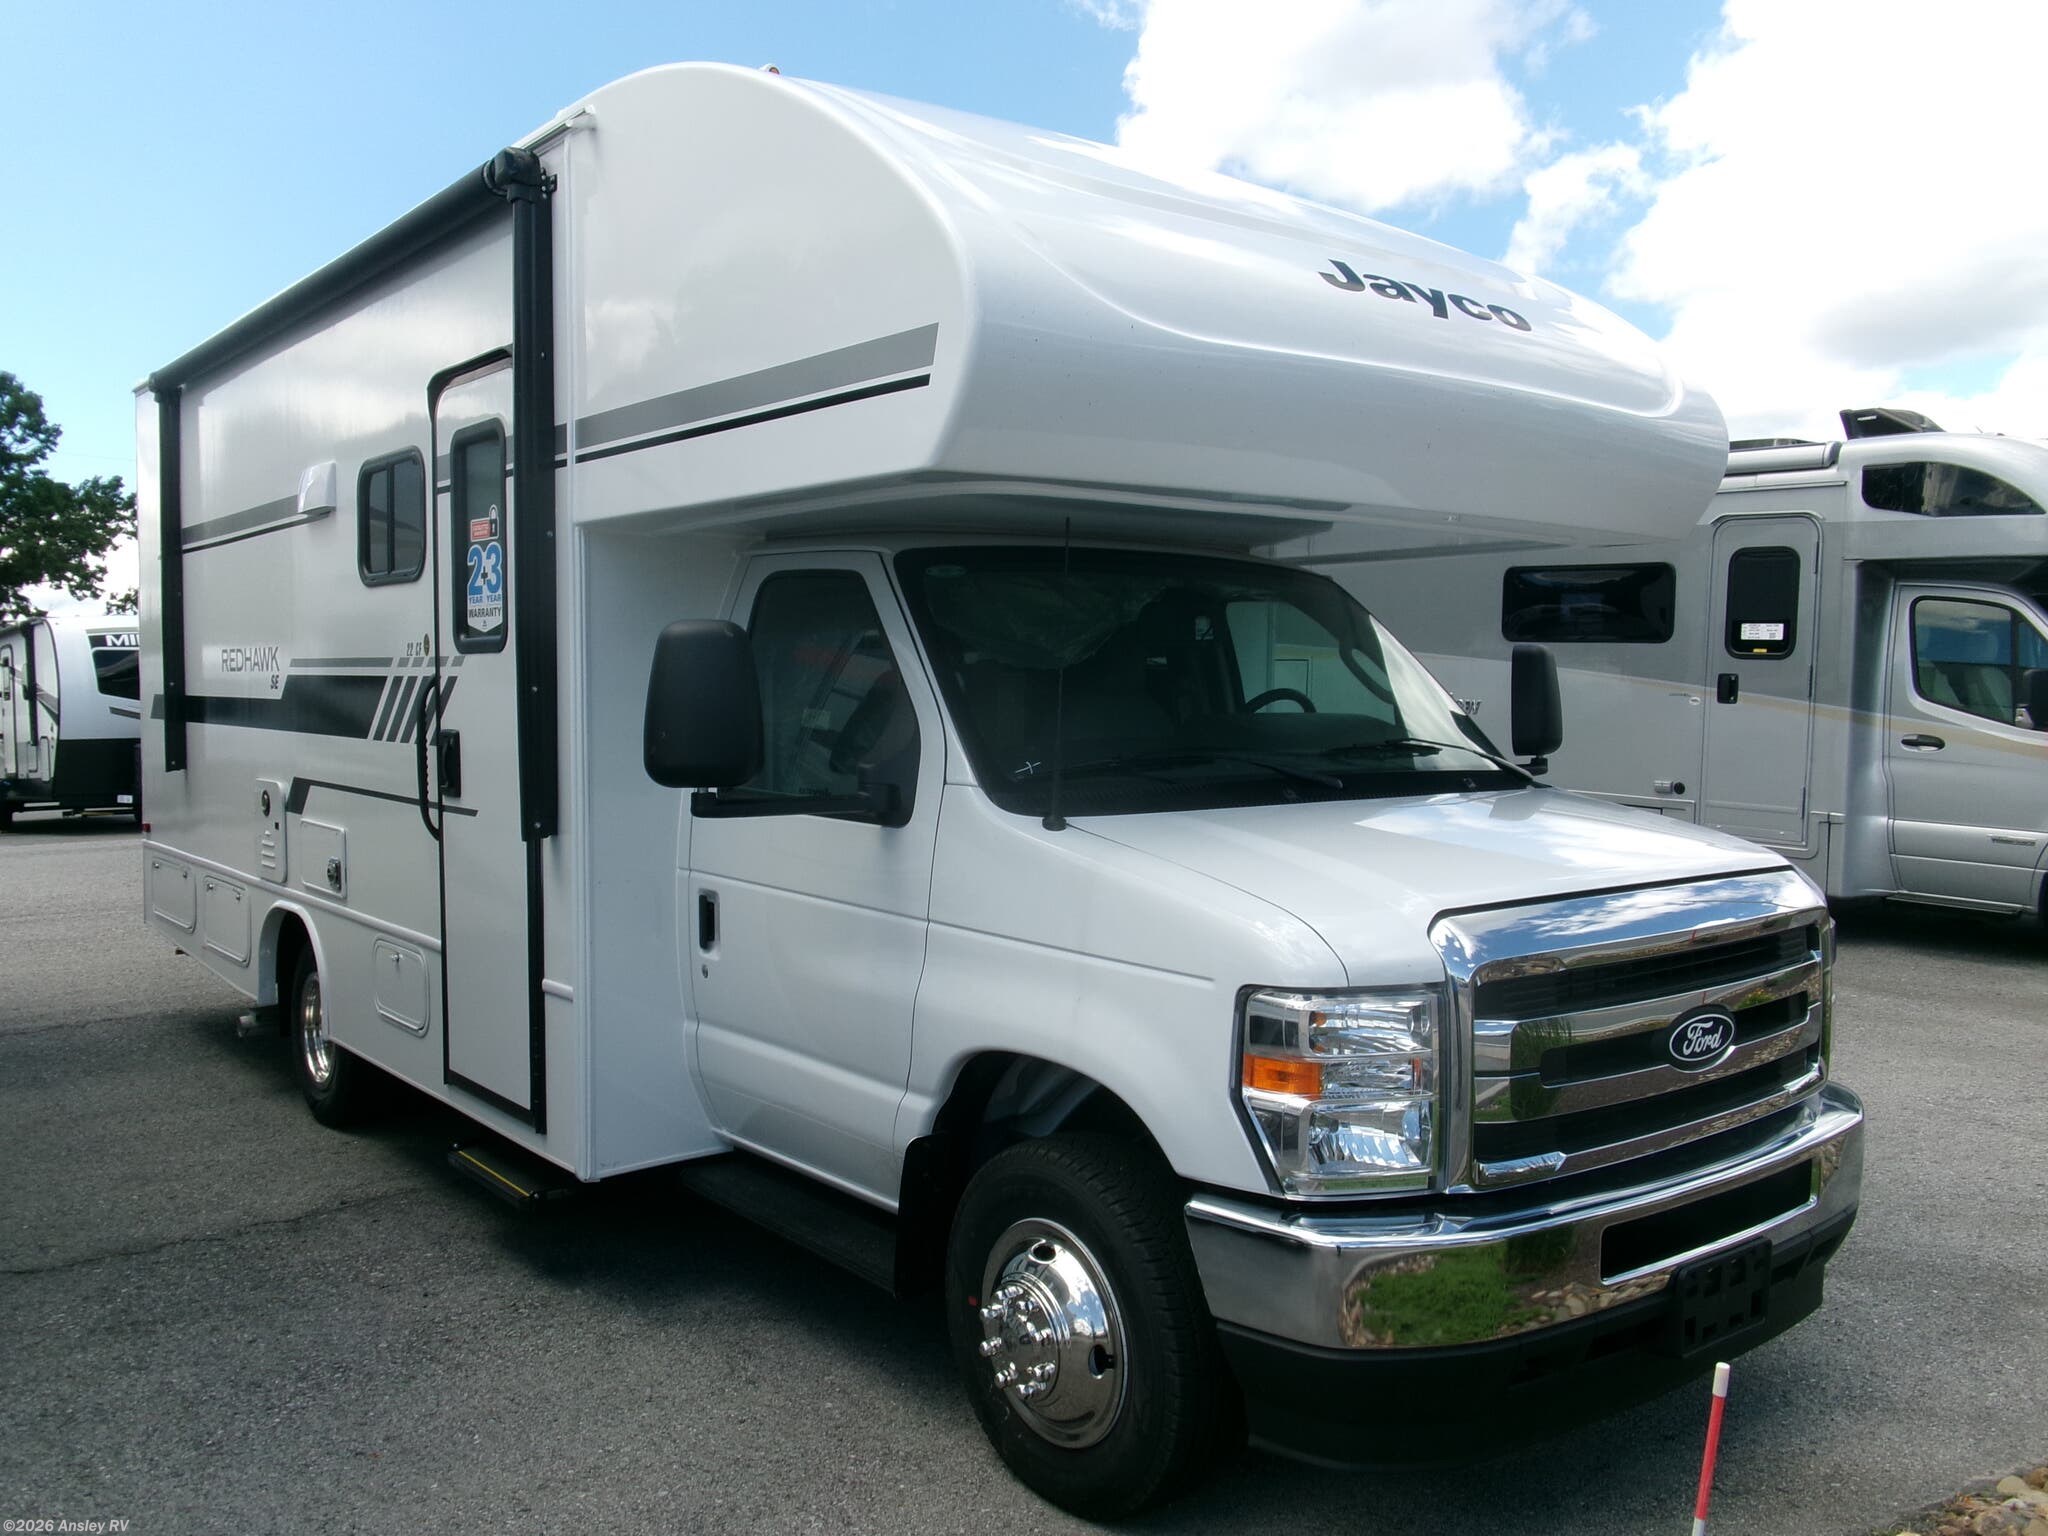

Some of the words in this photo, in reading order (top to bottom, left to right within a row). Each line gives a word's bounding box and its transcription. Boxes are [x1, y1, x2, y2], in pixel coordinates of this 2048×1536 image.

[1318, 259, 1532, 332] Jayco
[469, 595, 483, 605] YEAR
[486, 594, 502, 604] YEAR
[468, 606, 502, 619] WARRANTY
[221, 646, 280, 672] REDHAWK
[270, 674, 279, 690] SE
[1683, 1020, 1723, 1056] Ford
